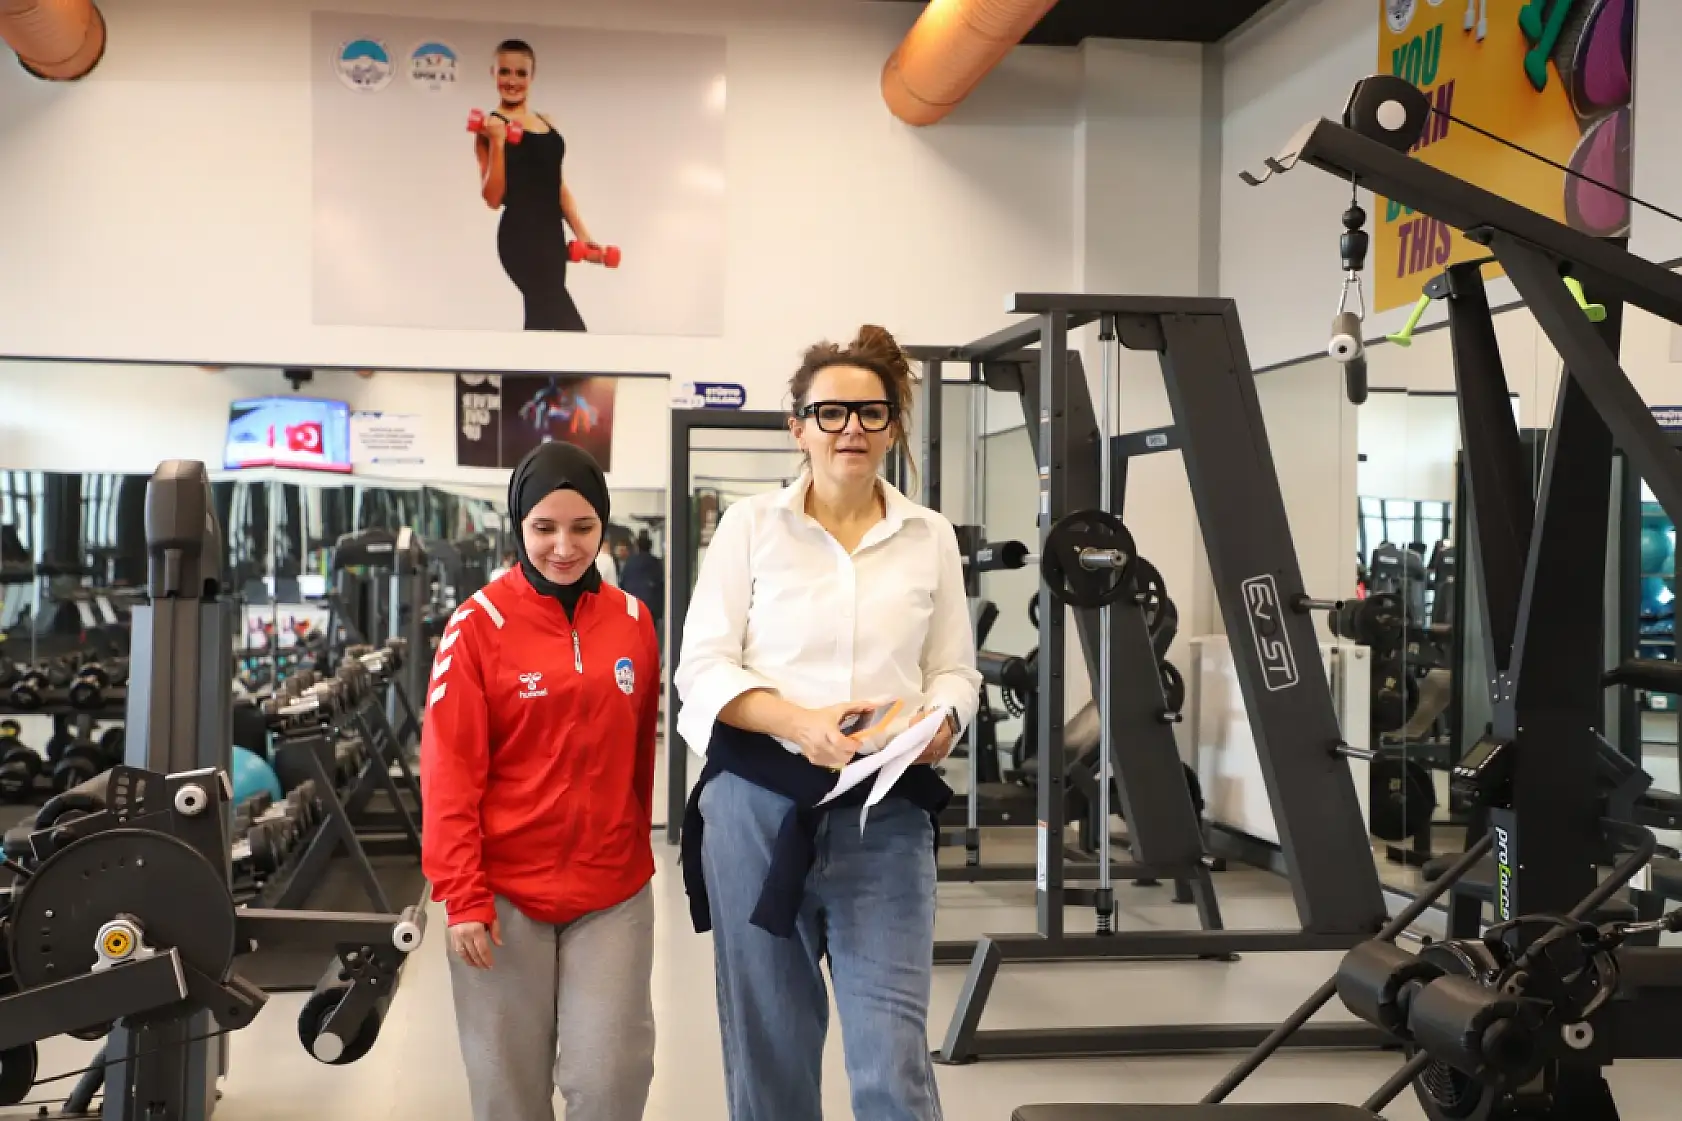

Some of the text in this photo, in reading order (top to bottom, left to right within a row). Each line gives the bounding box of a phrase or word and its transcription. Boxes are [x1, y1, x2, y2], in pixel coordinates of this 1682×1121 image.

[1392, 23, 1443, 88] YOU
[1396, 215, 1451, 279] THIS
[519, 688, 548, 699] hummel
